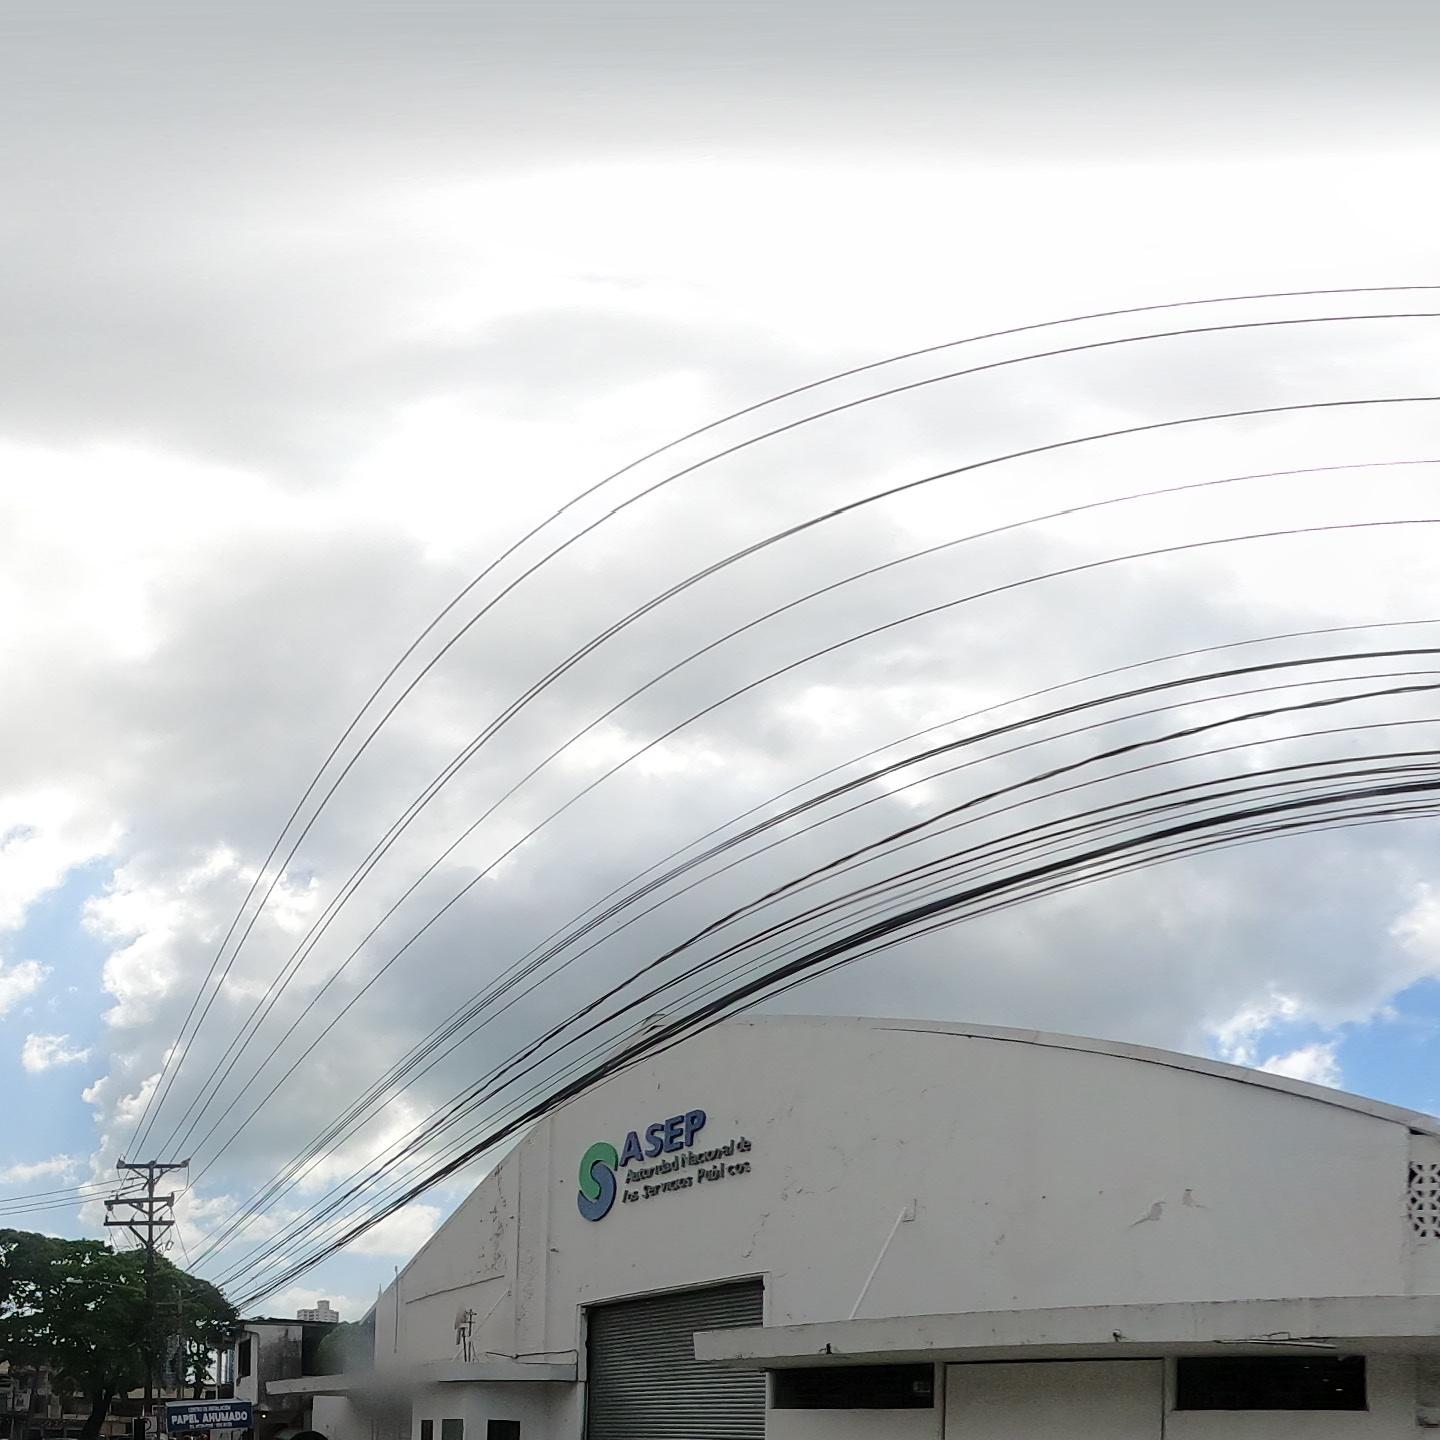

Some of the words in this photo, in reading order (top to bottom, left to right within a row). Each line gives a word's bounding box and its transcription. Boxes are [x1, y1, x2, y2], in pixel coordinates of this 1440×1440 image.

[620, 1110, 707, 1167] ASEP
[625, 1156, 679, 1184] Autoridad
[681, 1138, 734, 1168] Nacional
[737, 1136, 752, 1152] de
[622, 1189, 640, 1204] los
[643, 1175, 694, 1200] Servicios
[171, 1413, 200, 1425] PAPEL
[202, 1411, 248, 1423] AHUMADO
